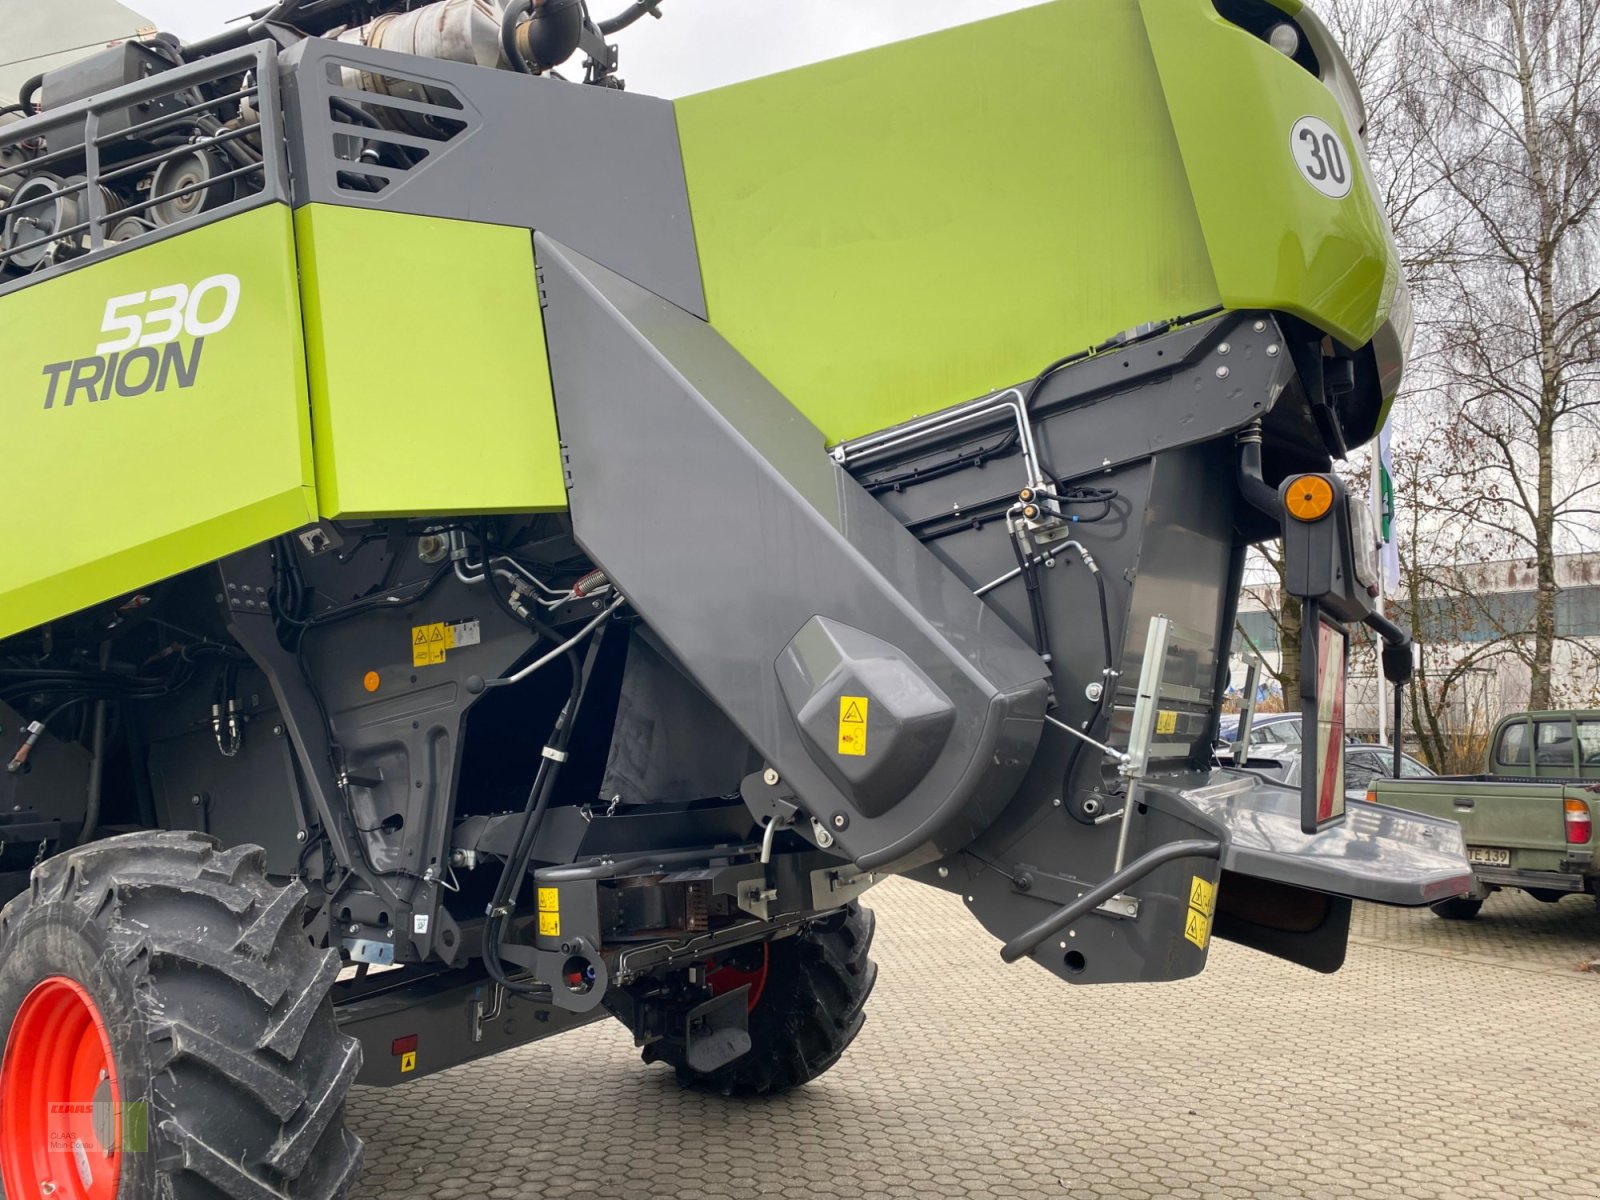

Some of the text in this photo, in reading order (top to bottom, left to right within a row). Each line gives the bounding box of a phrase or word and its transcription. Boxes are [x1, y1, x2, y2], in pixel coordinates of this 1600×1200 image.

[1299, 128, 1345, 184] 30
[95, 274, 240, 356] 530
[42, 336, 204, 410] TRION
[1484, 849, 1507, 862] 139
